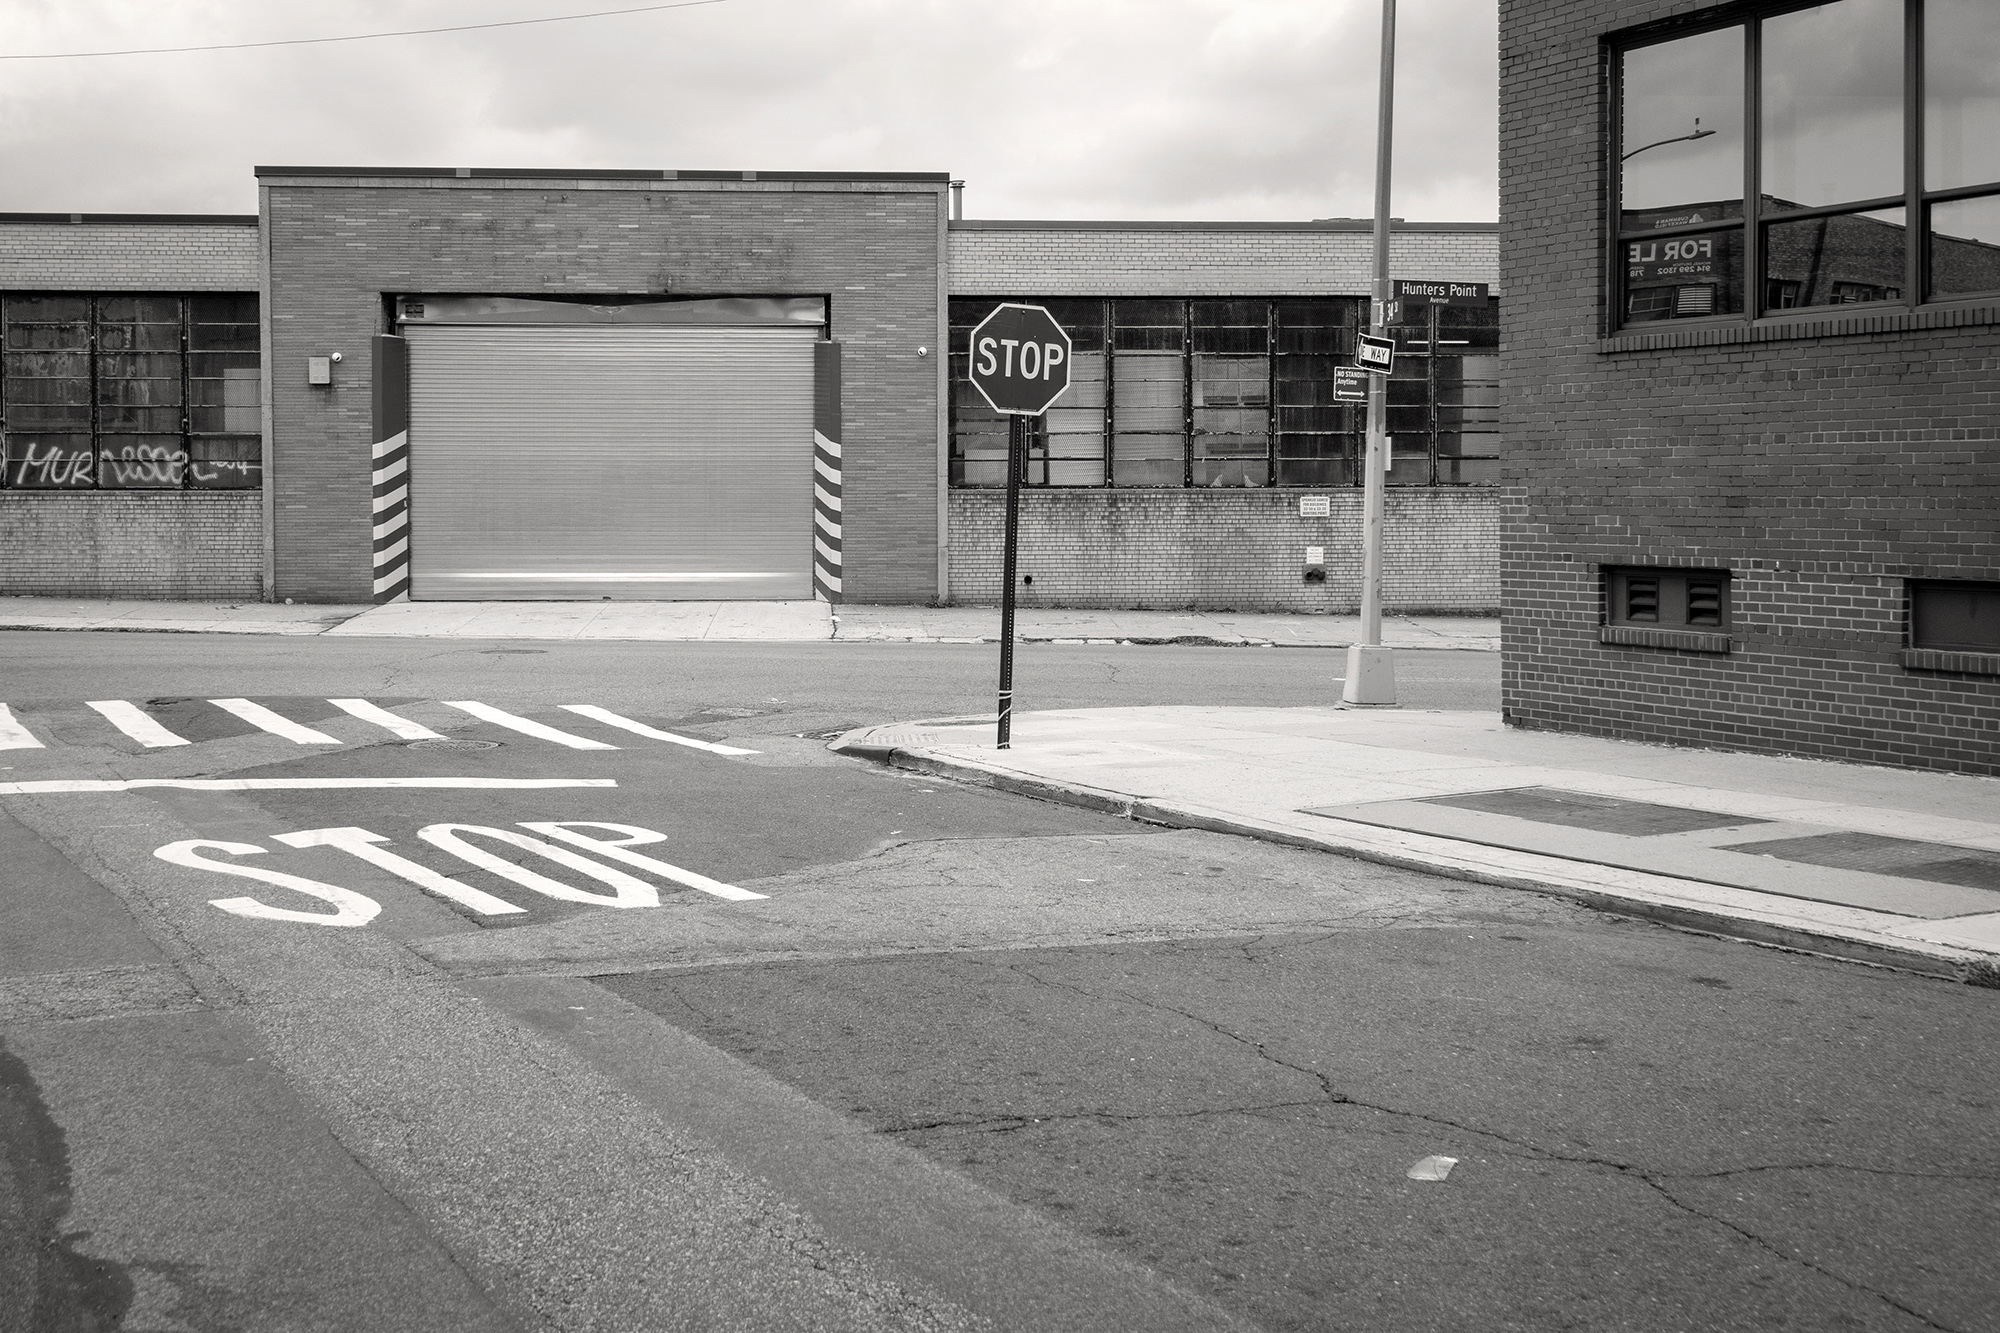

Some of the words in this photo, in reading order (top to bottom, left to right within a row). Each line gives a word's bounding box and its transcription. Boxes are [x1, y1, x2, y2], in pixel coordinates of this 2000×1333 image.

[1402, 282, 1445, 296] Hunters
[1450, 284, 1477, 297] Point
[1429, 296, 1449, 304] Avenue
[1387, 302, 1394, 322] 34
[977, 337, 1064, 380] STOP
[1370, 347, 1387, 362] WAY
[1336, 370, 1345, 378] NO
[1345, 371, 1369, 379] STANDING
[1337, 378, 1358, 386] Anytime
[153, 821, 770, 927] STOP
